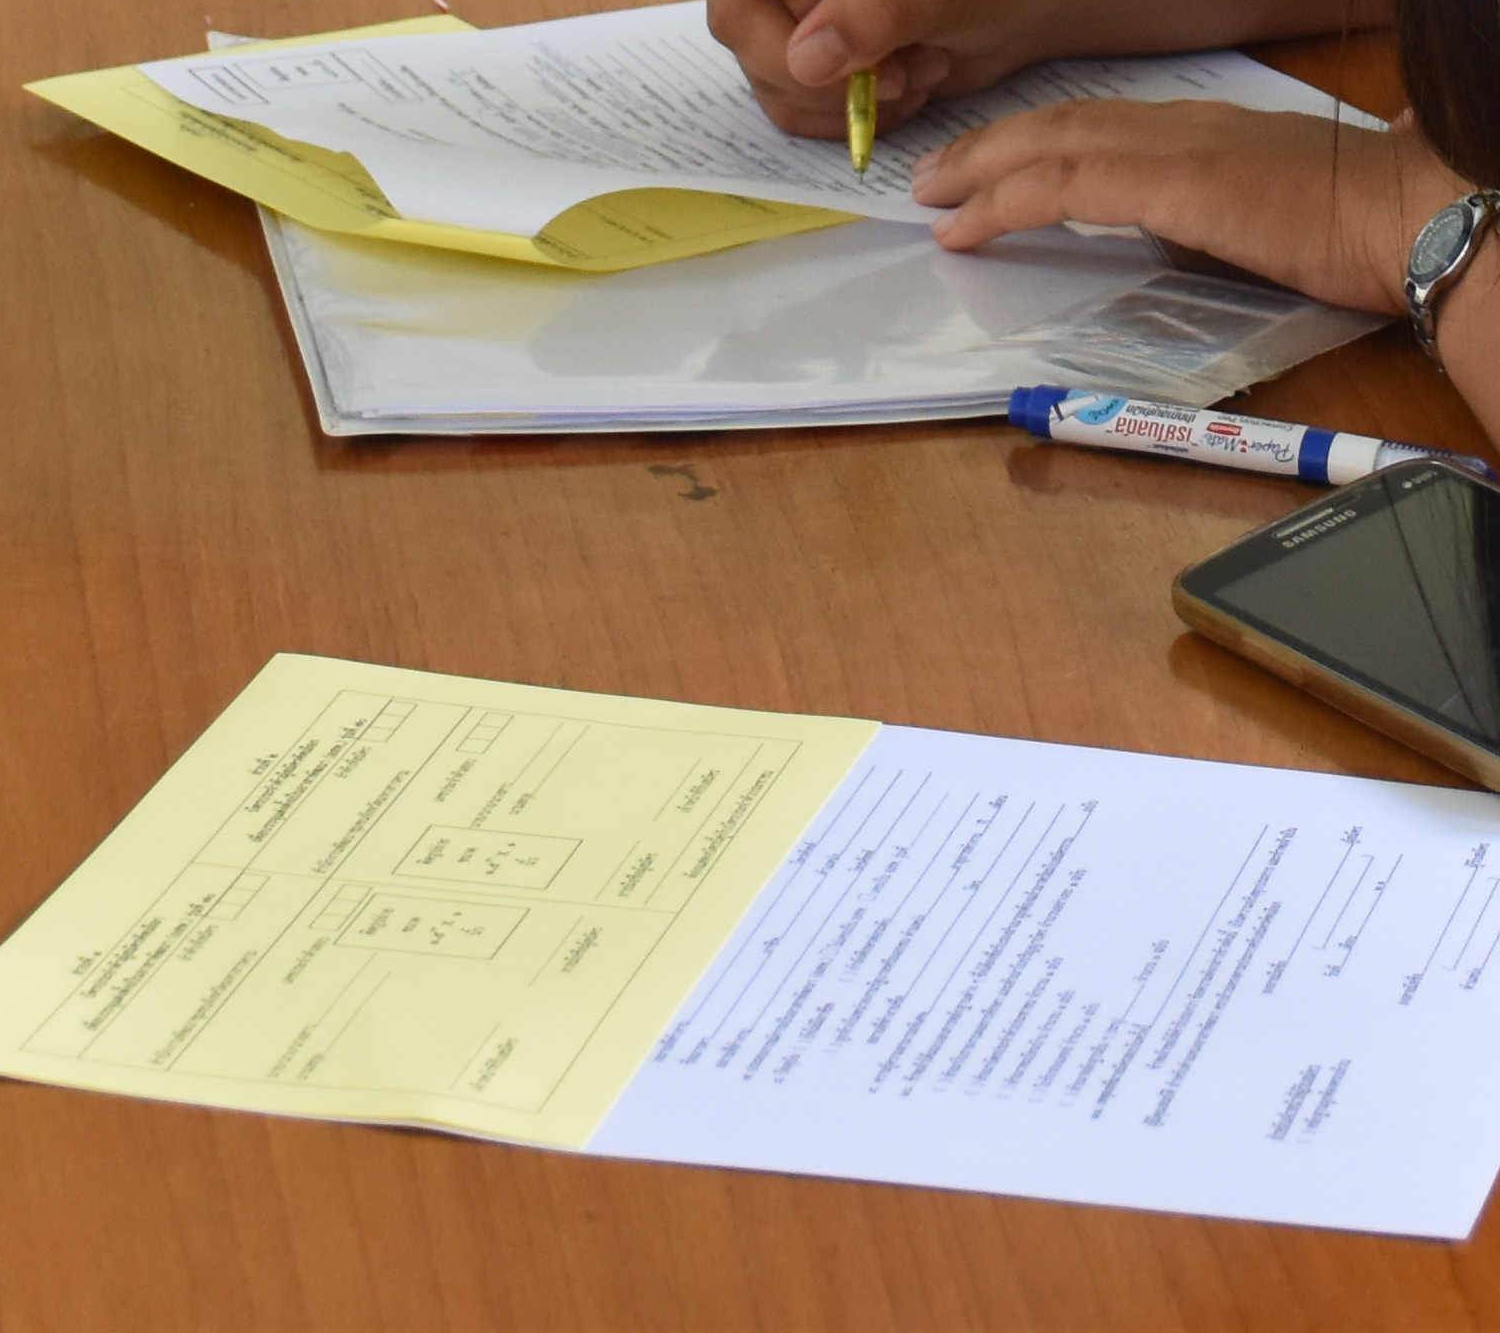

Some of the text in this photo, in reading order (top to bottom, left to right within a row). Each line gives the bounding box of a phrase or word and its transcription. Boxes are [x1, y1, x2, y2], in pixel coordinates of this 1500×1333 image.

[1203, 432, 1240, 454] Mate
[1248, 438, 1295, 463] Paper
[1282, 508, 1357, 549] SAMSUNG
